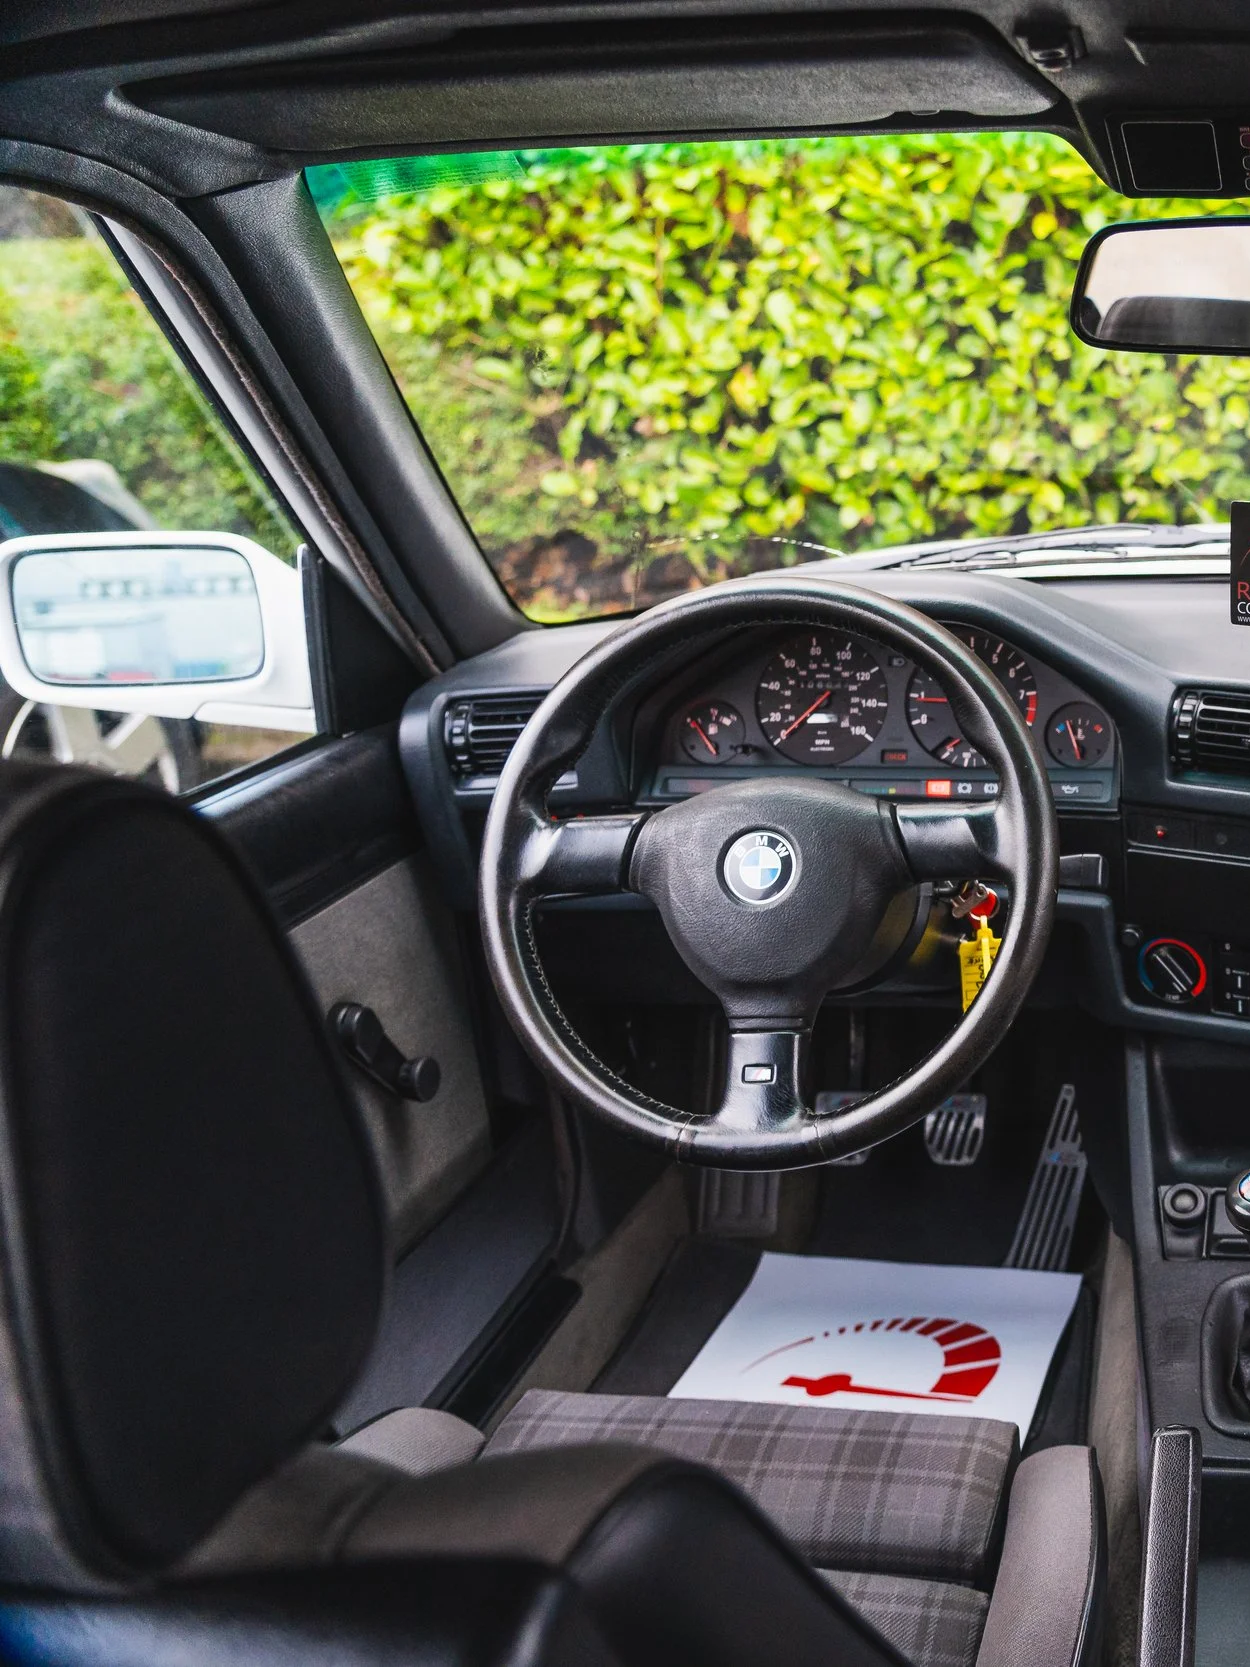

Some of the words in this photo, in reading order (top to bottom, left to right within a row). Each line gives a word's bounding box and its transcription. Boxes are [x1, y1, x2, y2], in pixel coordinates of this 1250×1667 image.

[836, 651, 851, 660] 100
[992, 653, 999, 665] 5
[784, 659, 796, 668] 60
[856, 672, 871, 681] 120
[1009, 667, 1016, 678] 6
[768, 681, 780, 691] 40
[1019, 689, 1025, 700] 7
[861, 699, 878, 708] 140
[769, 712, 781, 722] 20
[921, 714, 928, 725] 0
[850, 726, 867, 735] 160
[733, 835, 790, 858] BMW
